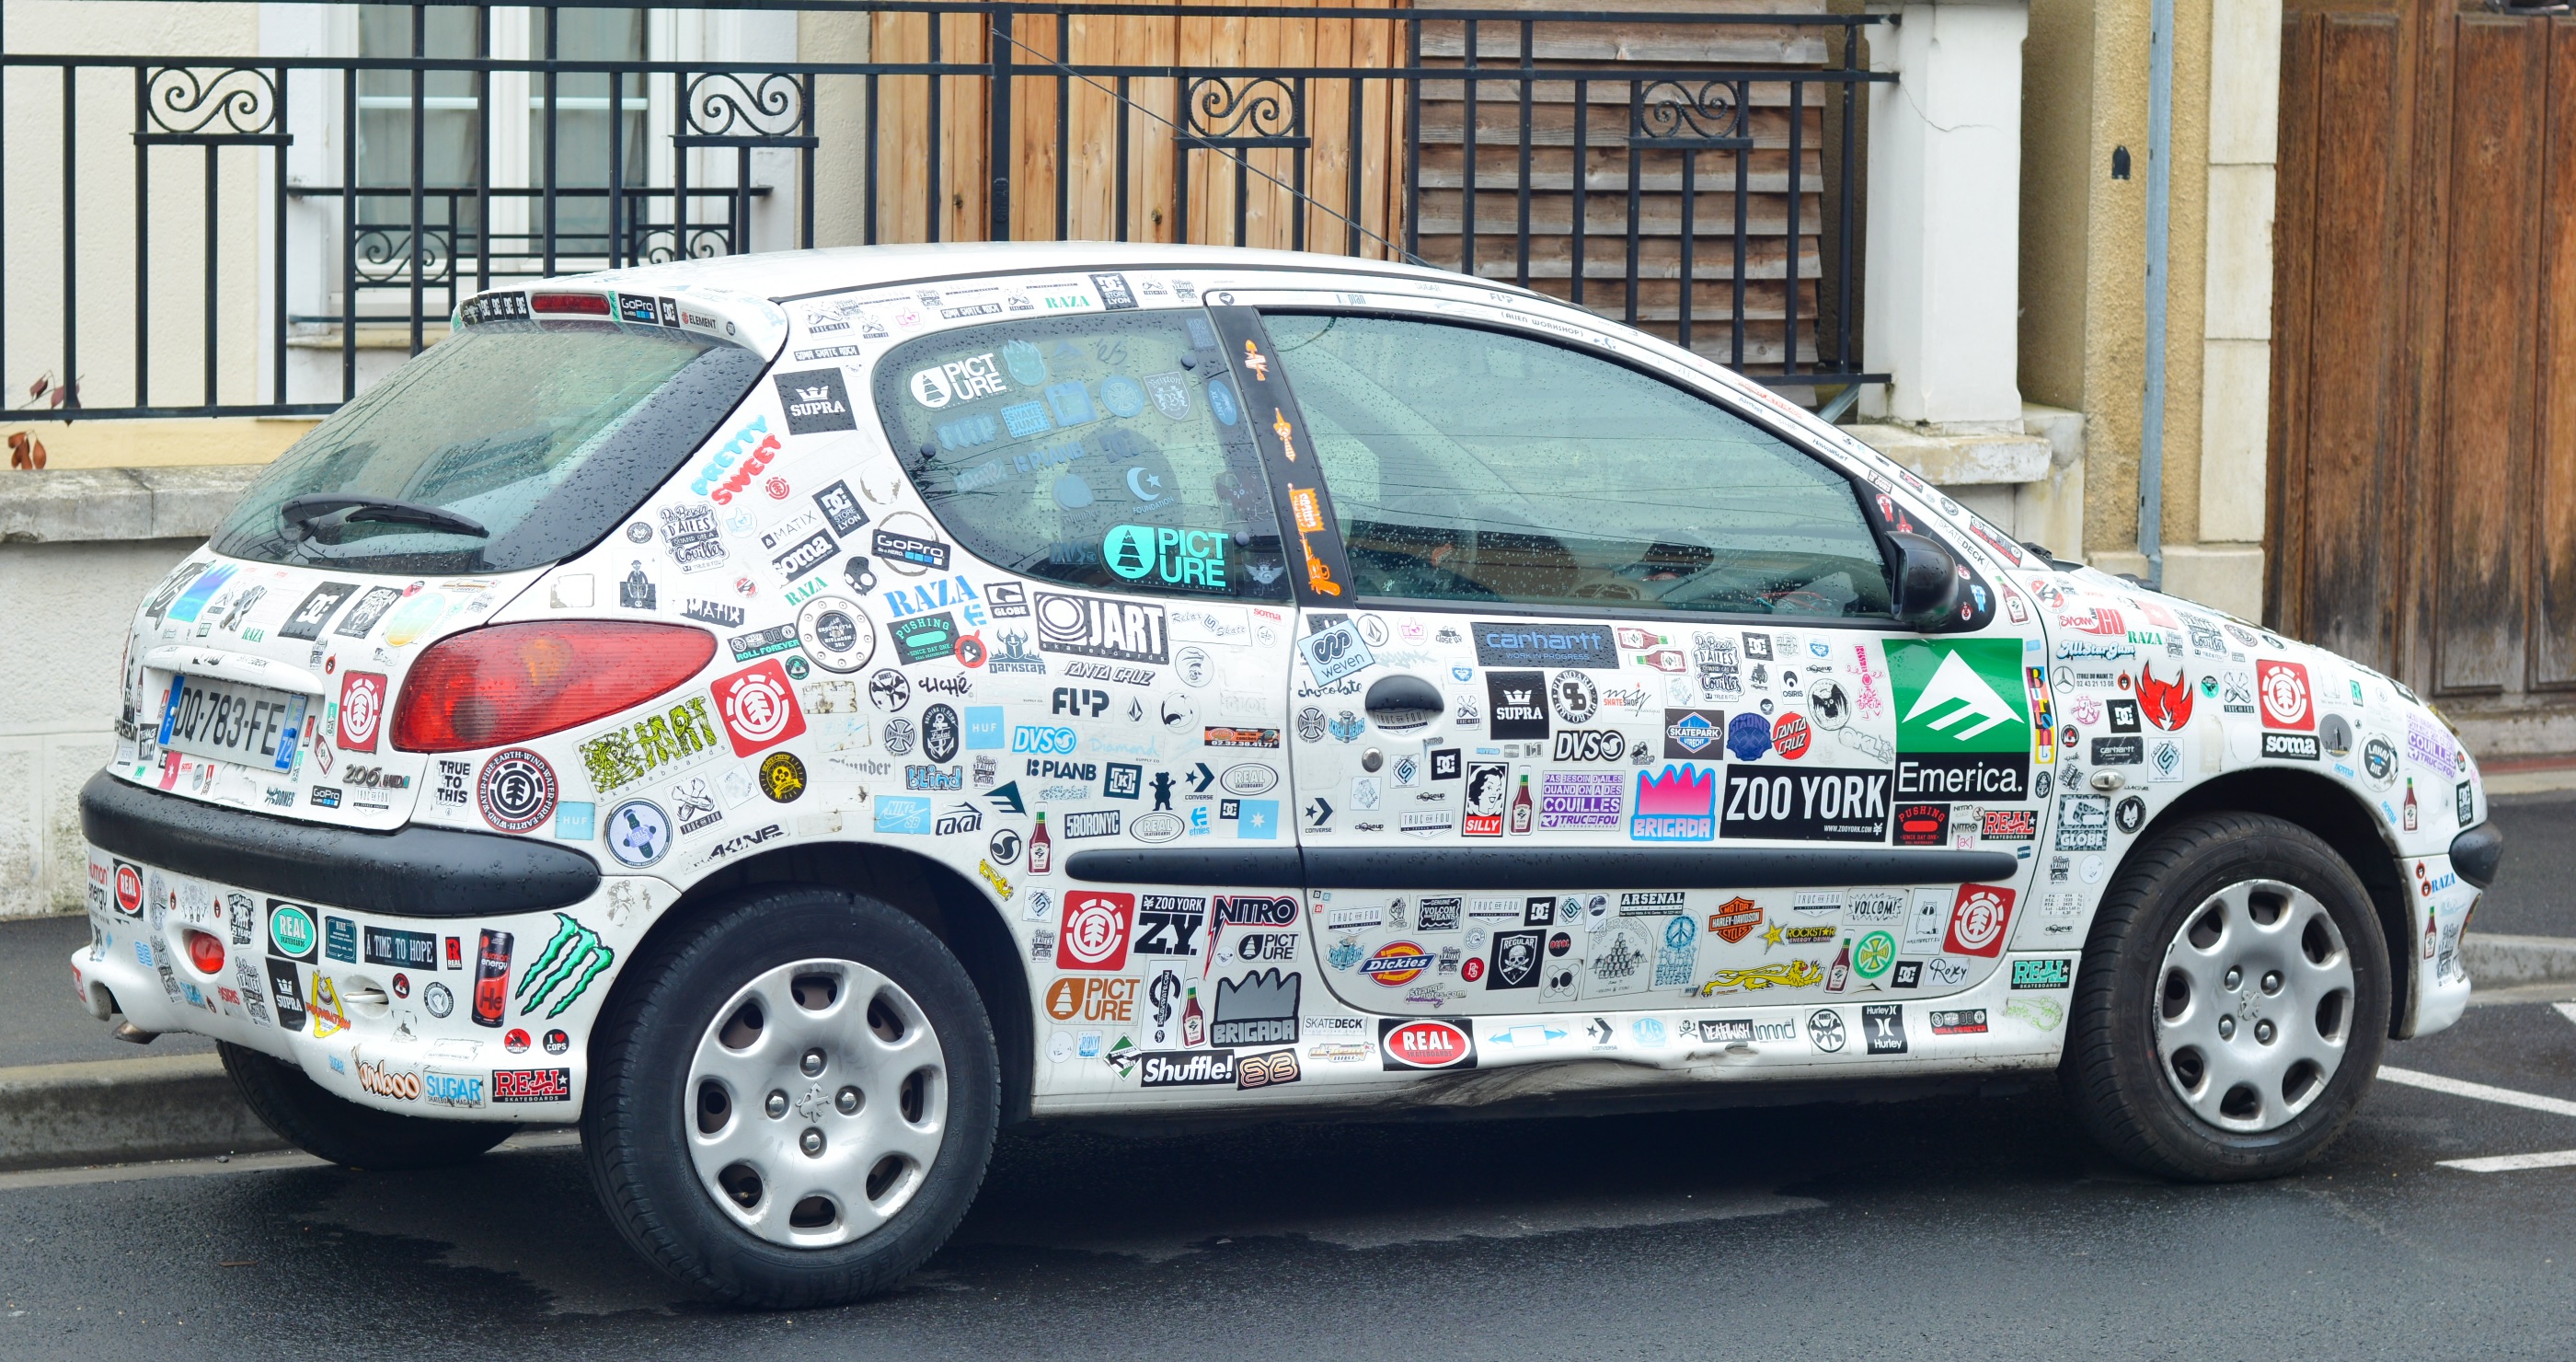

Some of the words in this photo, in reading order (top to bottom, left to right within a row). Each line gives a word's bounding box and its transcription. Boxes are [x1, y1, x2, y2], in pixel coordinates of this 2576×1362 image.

[1045, 295, 1090, 308] RAZA
[1104, 290, 1127, 298] STORE
[1107, 296, 1131, 306] LYON
[620, 297, 655, 311] GoPro
[688, 313, 718, 329] ELEMENT
[944, 353, 995, 381] PICT
[951, 373, 1007, 400] URE
[790, 400, 845, 417] SUPRA
[1009, 408, 1039, 422] SHAKE
[1011, 418, 1041, 432] JUNT
[690, 414, 768, 496] PRETTY
[711, 433, 782, 505] SWEET
[1133, 494, 1175, 514] FOUNDATION
[834, 505, 857, 524] STORE
[837, 514, 862, 531] LYON
[773, 511, 818, 541] MATIX
[877, 534, 944, 557] GoPro
[1157, 527, 1229, 558] PICT
[1159, 556, 1226, 588] URE
[783, 576, 829, 606] RAZA
[882, 574, 980, 618] RAZA
[994, 606, 1027, 617] GLOBE
[1170, 611, 1202, 624] Relax
[1253, 607, 1282, 621] soma
[241, 627, 265, 643] RAZA
[895, 618, 951, 641] PUSHING
[1087, 599, 1165, 655] JART
[1215, 625, 1247, 638] Skate
[1486, 632, 1602, 651] carhartt
[2128, 631, 2162, 645] RAZA
[736, 647, 758, 661] ROLL
[758, 638, 800, 655] FOREVER
[1543, 652, 1591, 661] PROGRESS
[1064, 660, 1112, 682] SANTA
[1111, 667, 1156, 687] CRUZ
[1320, 653, 1365, 678] weven
[878, 671, 892, 681] BONES
[1604, 698, 1639, 708] SKATESHOP
[173, 687, 287, 756] DQ-783-FE
[1496, 707, 1544, 721] SUPRA
[972, 722, 997, 733] HUF
[1669, 727, 1719, 737] SKATEPARK
[275, 736, 293, 763] 72
[1089, 736, 1160, 757] Diamond
[1684, 738, 1704, 747] UTRECHT
[1777, 732, 1807, 756] CRUZ
[2100, 745, 2135, 755] carhartt
[2266, 736, 2317, 755] soma
[2409, 731, 2456, 767] COUILLES
[2367, 744, 2390, 762] LAKAI
[439, 760, 471, 777] TRUE
[1041, 759, 1098, 781] PLANB
[1235, 769, 1266, 783] REAL
[1898, 761, 2023, 792] Emerica.
[2334, 763, 2354, 779] soma
[2369, 764, 2383, 777] DIE
[443, 774, 463, 790] TO
[906, 764, 962, 791] blind
[1545, 775, 1561, 783] PAS
[1593, 775, 1623, 783] D'AILES
[313, 789, 340, 800] GoPro
[437, 788, 468, 803] THIS
[1726, 777, 1793, 821] ZOO
[1800, 775, 1886, 820] YORK
[887, 802, 915, 815] NIKE
[1543, 798, 1621, 813] COUILLES
[562, 815, 589, 826] HUF
[1898, 805, 1946, 823] PUSHING
[904, 817, 919, 828] SB
[1066, 811, 1120, 837] 5BORONYC
[1142, 818, 1173, 832] REAL
[1466, 818, 1500, 832] SILLY
[1634, 816, 1710, 838] BRIGADA
[1823, 825, 1872, 833] WWW.ZOOYORK.COM
[1983, 811, 2035, 835] REAL
[631, 827, 650, 841] GIRLS
[2060, 833, 2105, 847] GLOBE
[120, 873, 138, 898] REAL
[2431, 871, 2456, 894] RAZA
[1155, 897, 1175, 911] ZOO
[1175, 898, 1203, 912] YORK
[1621, 893, 1684, 906] ARSENAL
[1213, 895, 1299, 926] NITRO
[1423, 906, 1458, 915] VOLCOM
[1723, 903, 1749, 914] MOTOR
[1853, 901, 1898, 915] VOLCOM!
[1431, 913, 1456, 921] JEANS
[1711, 911, 1763, 929] HARLEY-DAVIDSON
[278, 913, 306, 940] REAL
[1721, 927, 1749, 942] CYCLES
[1263, 933, 1299, 947] PICT
[1503, 937, 1535, 950] REGULAR
[1788, 936, 1811, 944] ENERGY
[1812, 935, 1832, 943] DRINK
[365, 933, 372, 954] A
[374, 936, 393, 958] TIME
[397, 937, 407, 958] TO
[410, 938, 433, 964] HOPE
[481, 950, 509, 960] Human
[1263, 946, 1295, 960] URE
[481, 959, 508, 970] energy
[1366, 955, 1427, 972] Dickies
[1929, 958, 1968, 985] Roxy
[2013, 960, 2070, 984] REAL
[1087, 978, 1141, 1000] PICT
[1409, 983, 1444, 998] Strange
[1420, 989, 1466, 999] notes.com
[276, 994, 304, 1012] SUPRA
[479, 986, 503, 1011] He
[1084, 1000, 1133, 1022] URE
[1866, 1006, 1890, 1016] Hurley
[1213, 1019, 1295, 1044] BRIGADA
[1305, 1017, 1363, 1030] SKATEDECK
[1702, 1022, 1751, 1041] DEATHWISH
[1933, 1026, 1954, 1035] ROLL
[1953, 1024, 1988, 1033] FOREVER
[546, 1043, 568, 1052] COPS
[1402, 1030, 1454, 1051] REAL
[1873, 1038, 1903, 1050] Hurley
[1407, 1050, 1453, 1058] SKATEBOARDS
[1144, 1053, 1235, 1082] Shuffle!
[426, 1075, 482, 1100] SUGAR
[495, 1069, 567, 1095] REAL
